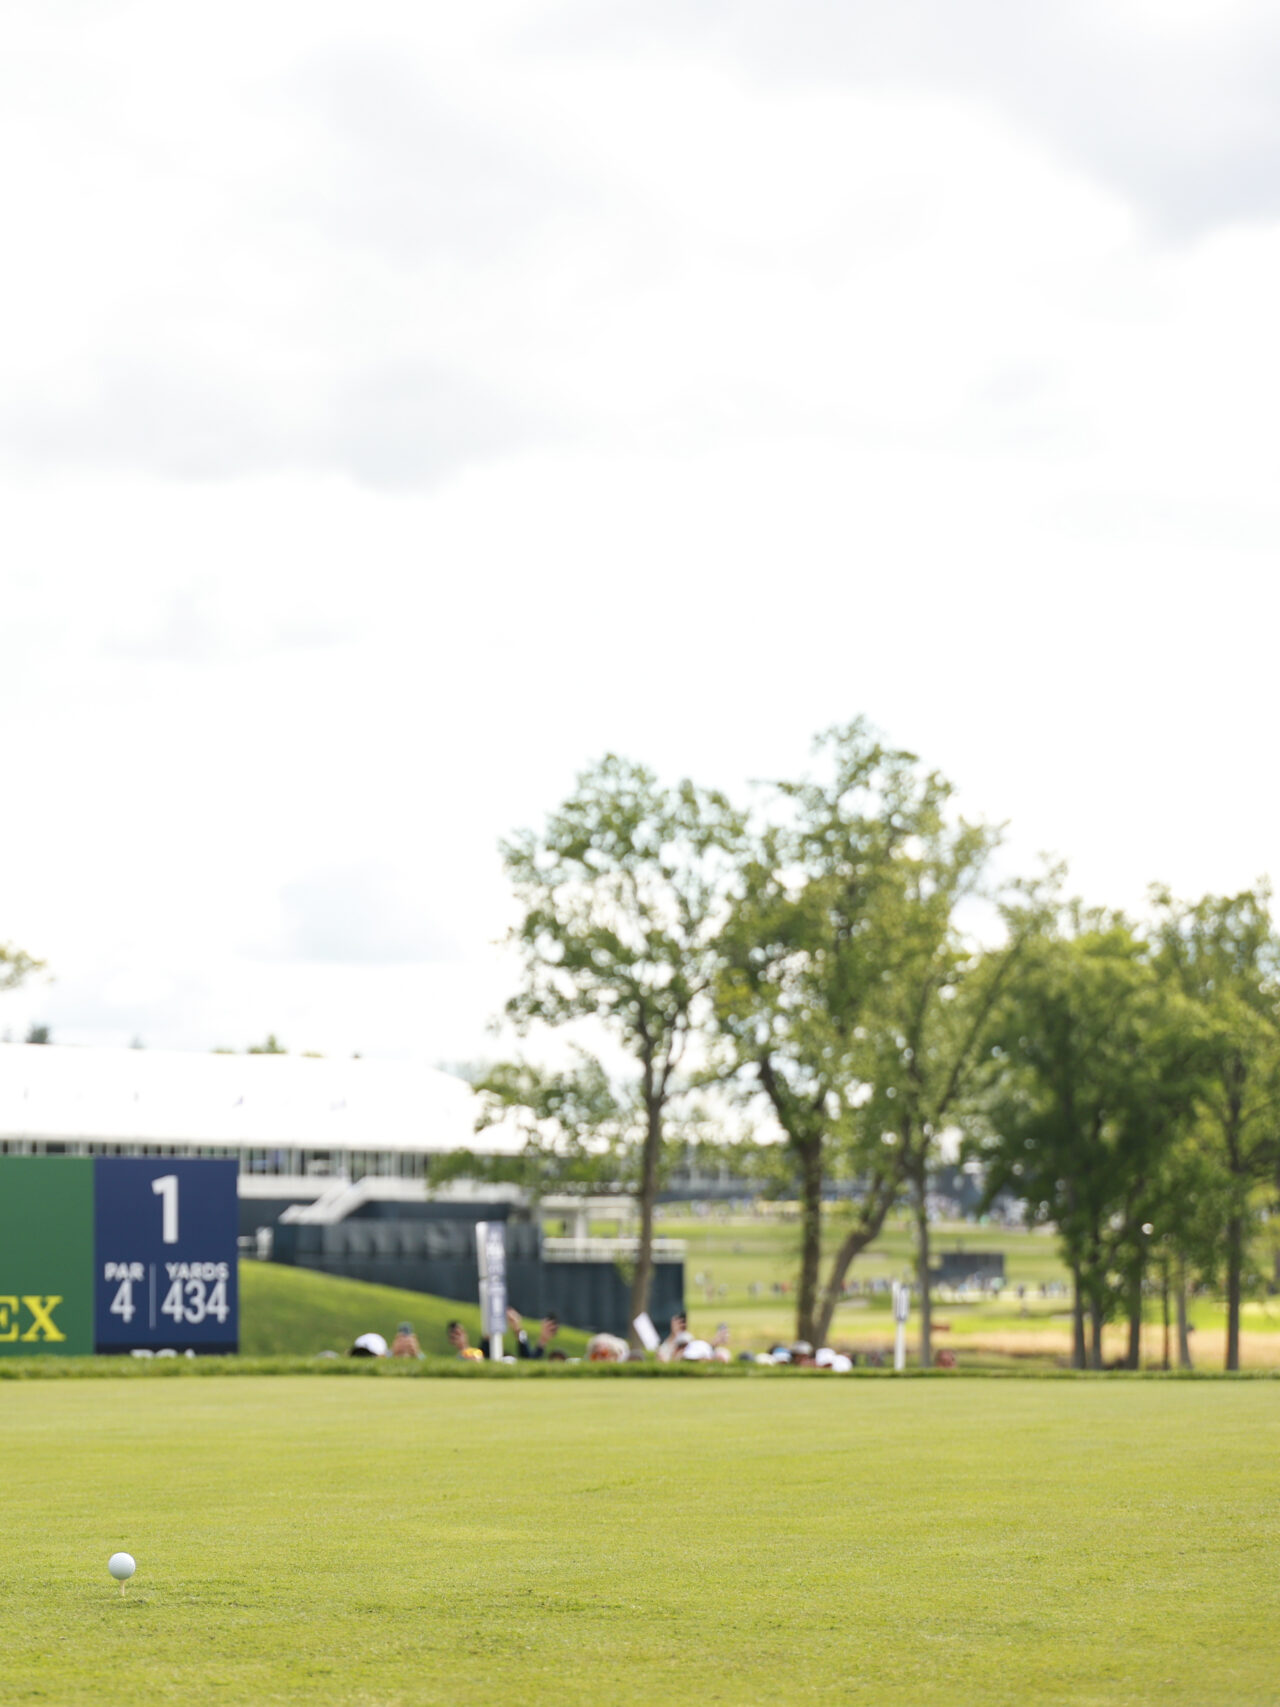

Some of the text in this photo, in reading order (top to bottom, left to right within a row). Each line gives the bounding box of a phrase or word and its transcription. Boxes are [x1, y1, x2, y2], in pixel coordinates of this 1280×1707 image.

[151, 1174, 179, 1244] 1
[104, 1261, 230, 1282] PAR YARDS
[109, 1278, 230, 1324] 4 434
